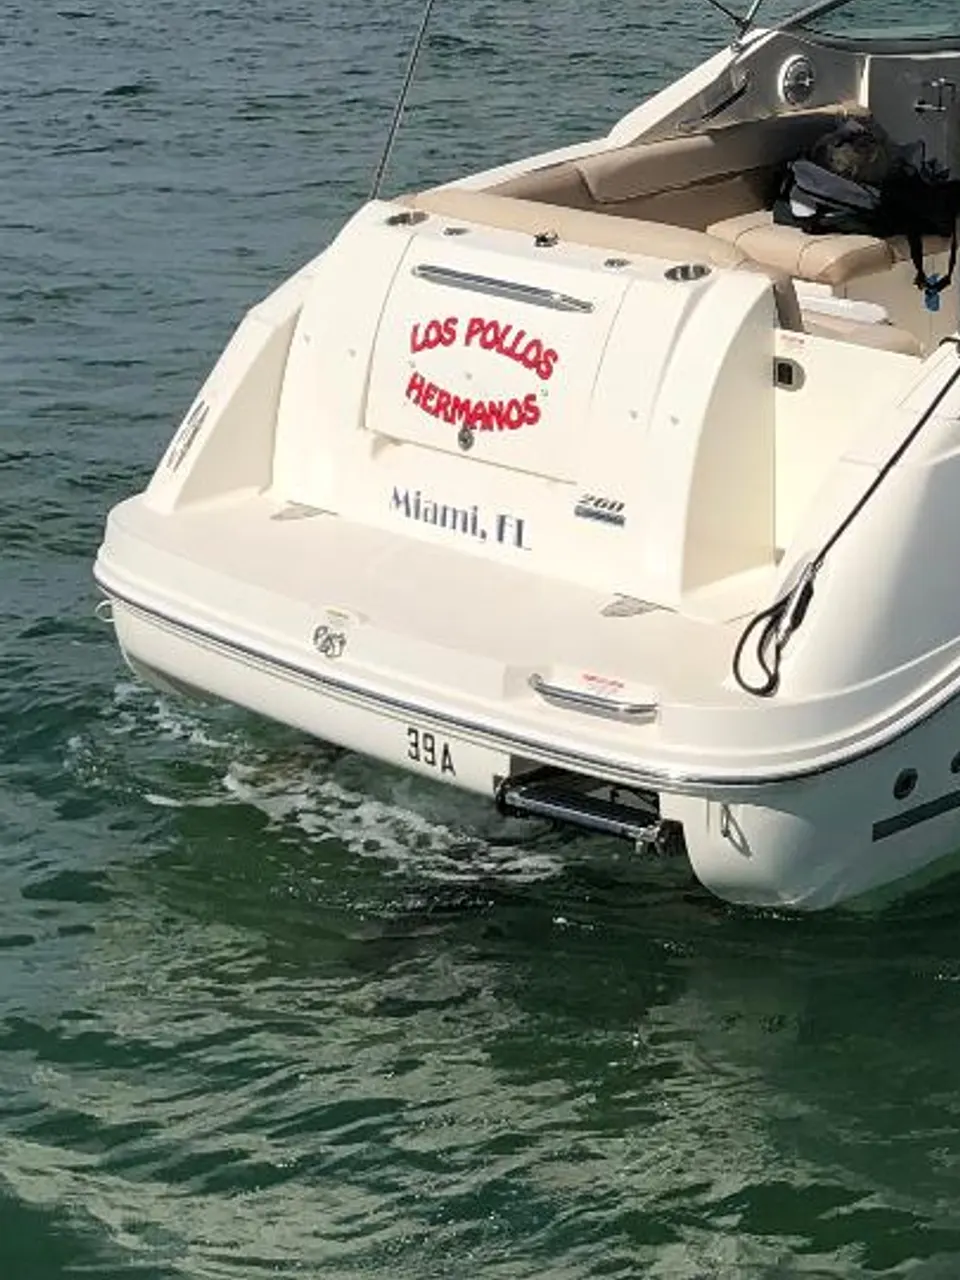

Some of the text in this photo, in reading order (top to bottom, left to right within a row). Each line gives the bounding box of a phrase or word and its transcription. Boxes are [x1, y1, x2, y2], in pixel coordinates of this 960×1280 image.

[410, 317, 559, 380] LOS POLLOS
[405, 371, 541, 432] HERMANOS
[389, 485, 532, 551] Miami, FL
[407, 727, 456, 777] 39A
